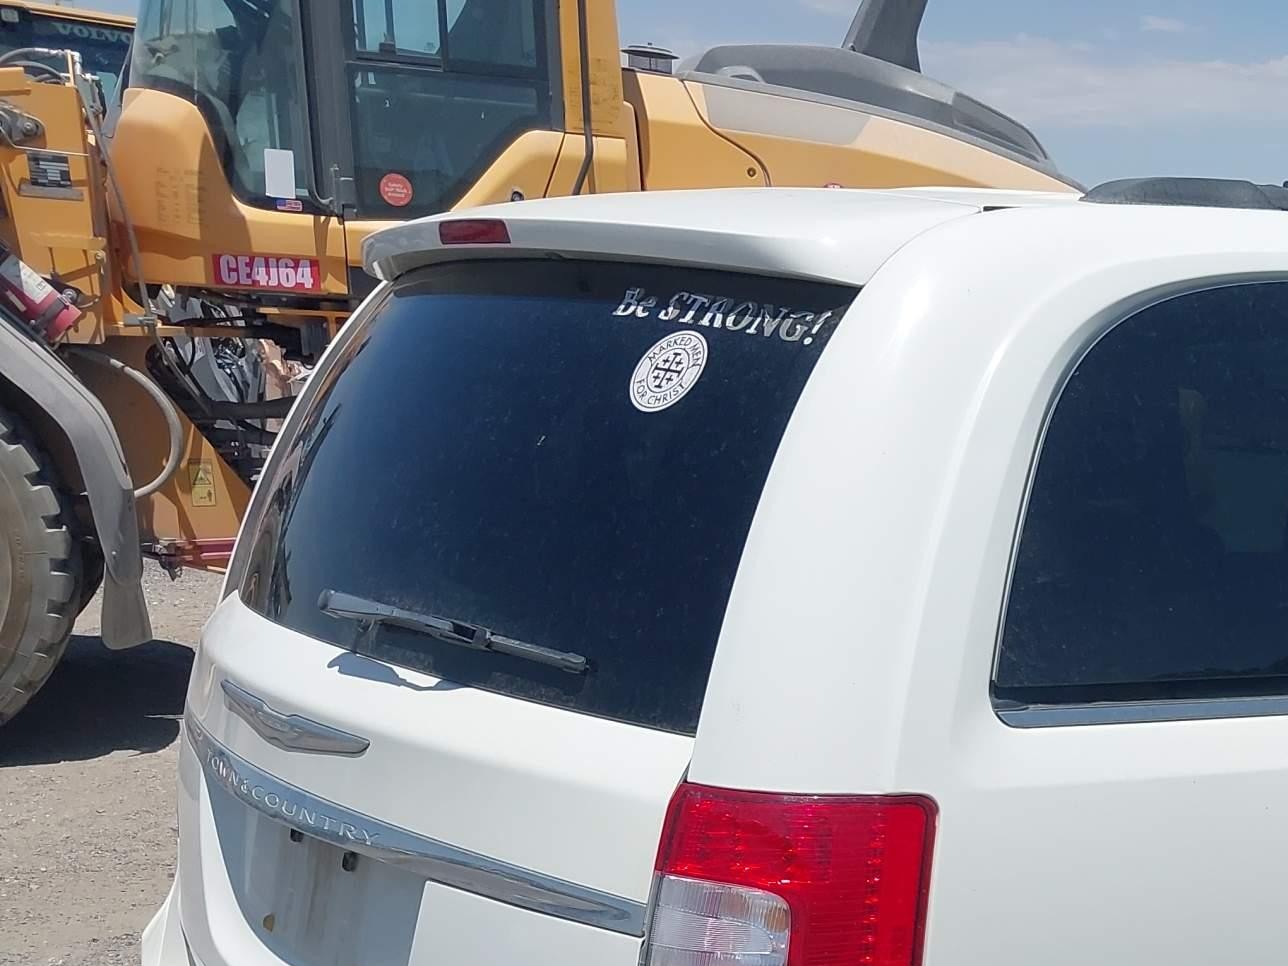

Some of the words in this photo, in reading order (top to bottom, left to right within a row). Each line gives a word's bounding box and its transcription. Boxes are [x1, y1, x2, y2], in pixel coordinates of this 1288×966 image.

[51, 22, 133, 44] VOLVO
[220, 255, 313, 288] CE4J64
[612, 288, 656, 316] Be
[658, 292, 831, 345] STRONG!
[648, 337, 692, 366] MARKED
[687, 343, 702, 369] MEN
[636, 379, 647, 400] FOR
[648, 383, 684, 405] CHRIST
